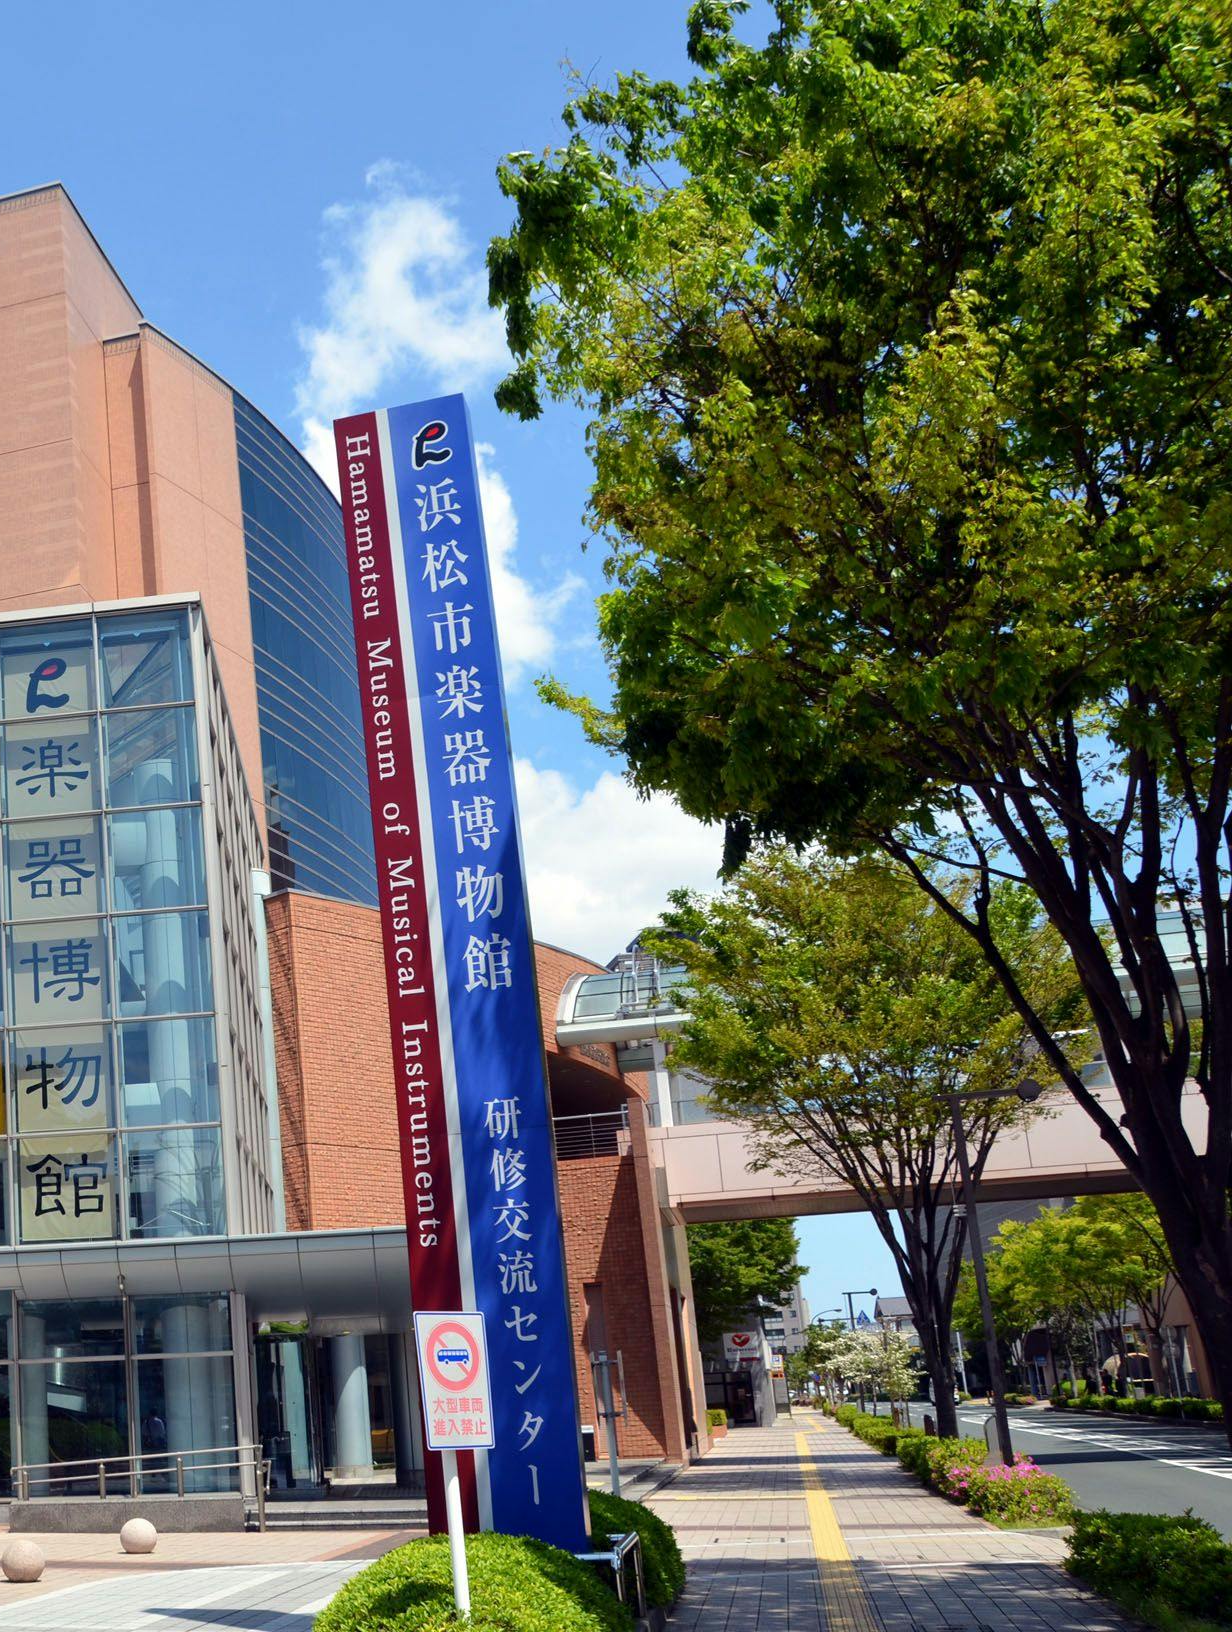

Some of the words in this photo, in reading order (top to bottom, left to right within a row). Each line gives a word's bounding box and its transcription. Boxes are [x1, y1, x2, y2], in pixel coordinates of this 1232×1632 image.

[345, 432, 382, 618] Hamamatsu
[367, 637, 398, 781] Museum
[414, 477, 513, 993] 浜松市楽器博物館
[382, 802, 411, 836] of
[16, 739, 107, 1219] 楽器博物館
[388, 856, 425, 998] Musical
[401, 1020, 438, 1249] Instruments
[484, 1096, 546, 1505] 研修交流センター
[433, 1397, 483, 1414] 大型車両
[434, 1418, 487, 1436] 進入禁止
